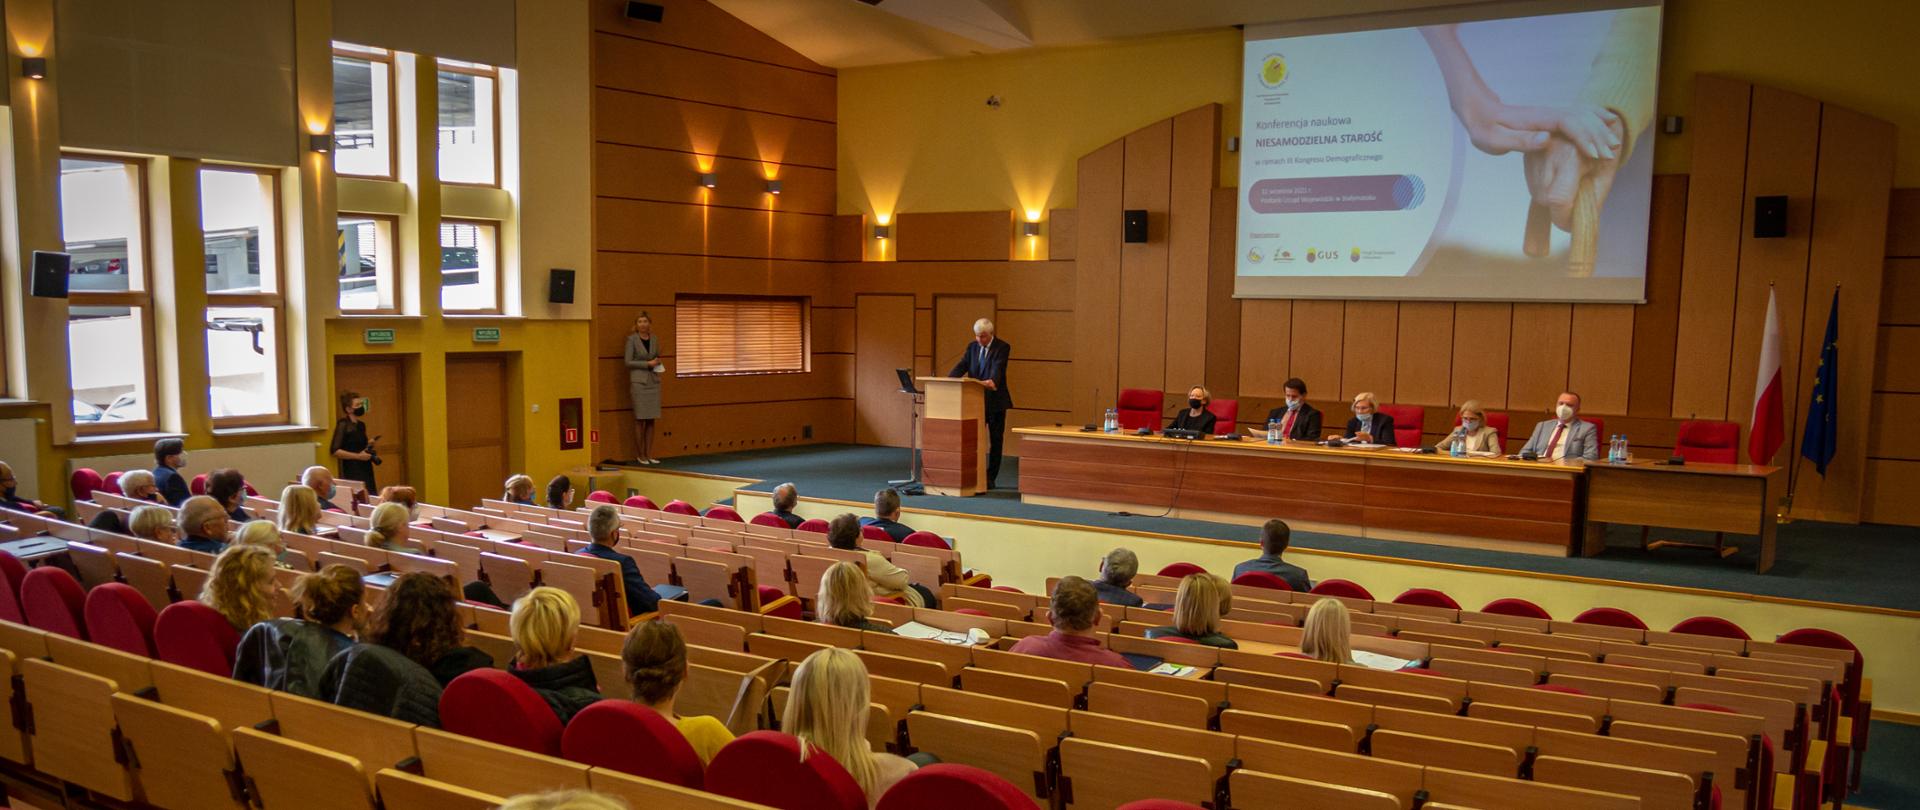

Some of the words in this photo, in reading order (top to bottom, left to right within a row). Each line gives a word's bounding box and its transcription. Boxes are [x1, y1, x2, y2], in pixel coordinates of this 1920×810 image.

[1256, 119, 1308, 130] Konferencja
[1311, 116, 1352, 127] naukowa
[1255, 135, 1338, 148] NIESAMODZIELNA
[1340, 130, 1383, 144] STAROŚĆ
[1317, 250, 1340, 260] GUS
